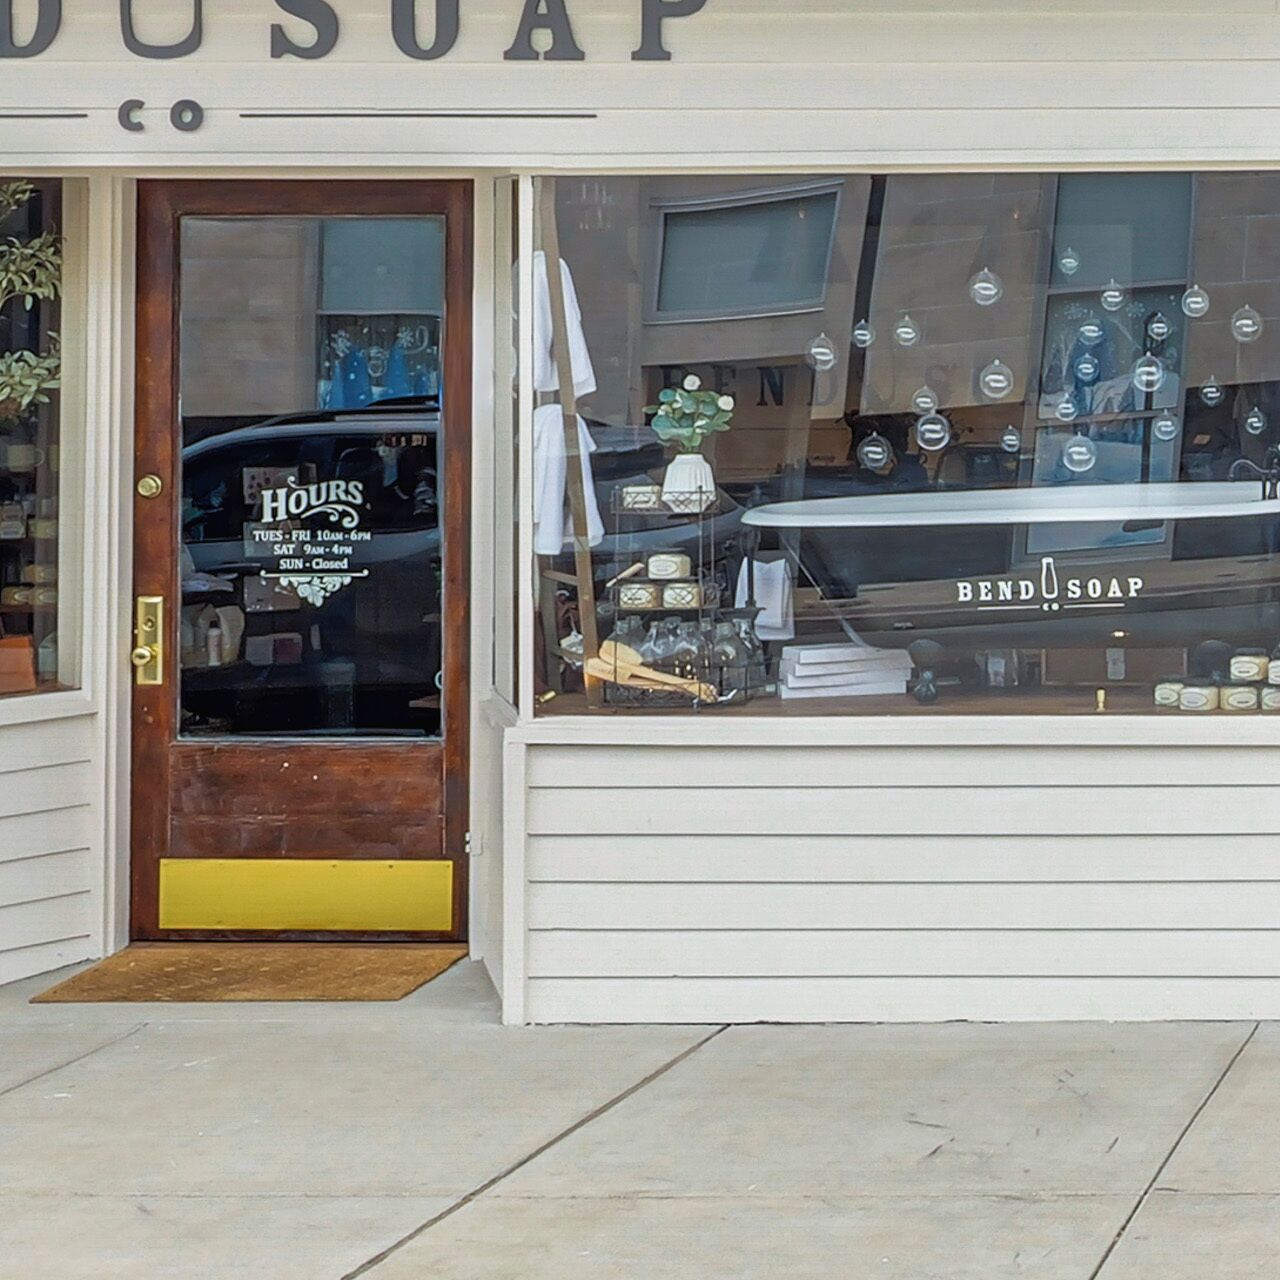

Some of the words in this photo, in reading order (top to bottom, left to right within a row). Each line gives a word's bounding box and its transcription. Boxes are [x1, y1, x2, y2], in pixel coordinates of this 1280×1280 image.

[261, 479, 364, 523] HOURS
[253, 530, 283, 541] TUES
[292, 530, 311, 541] FRI
[273, 544, 295, 555] SAT
[279, 558, 303, 570] SUN
[312, 558, 348, 569] Closed
[957, 580, 1035, 602] BEND
[1067, 577, 1143, 598] SOAP
